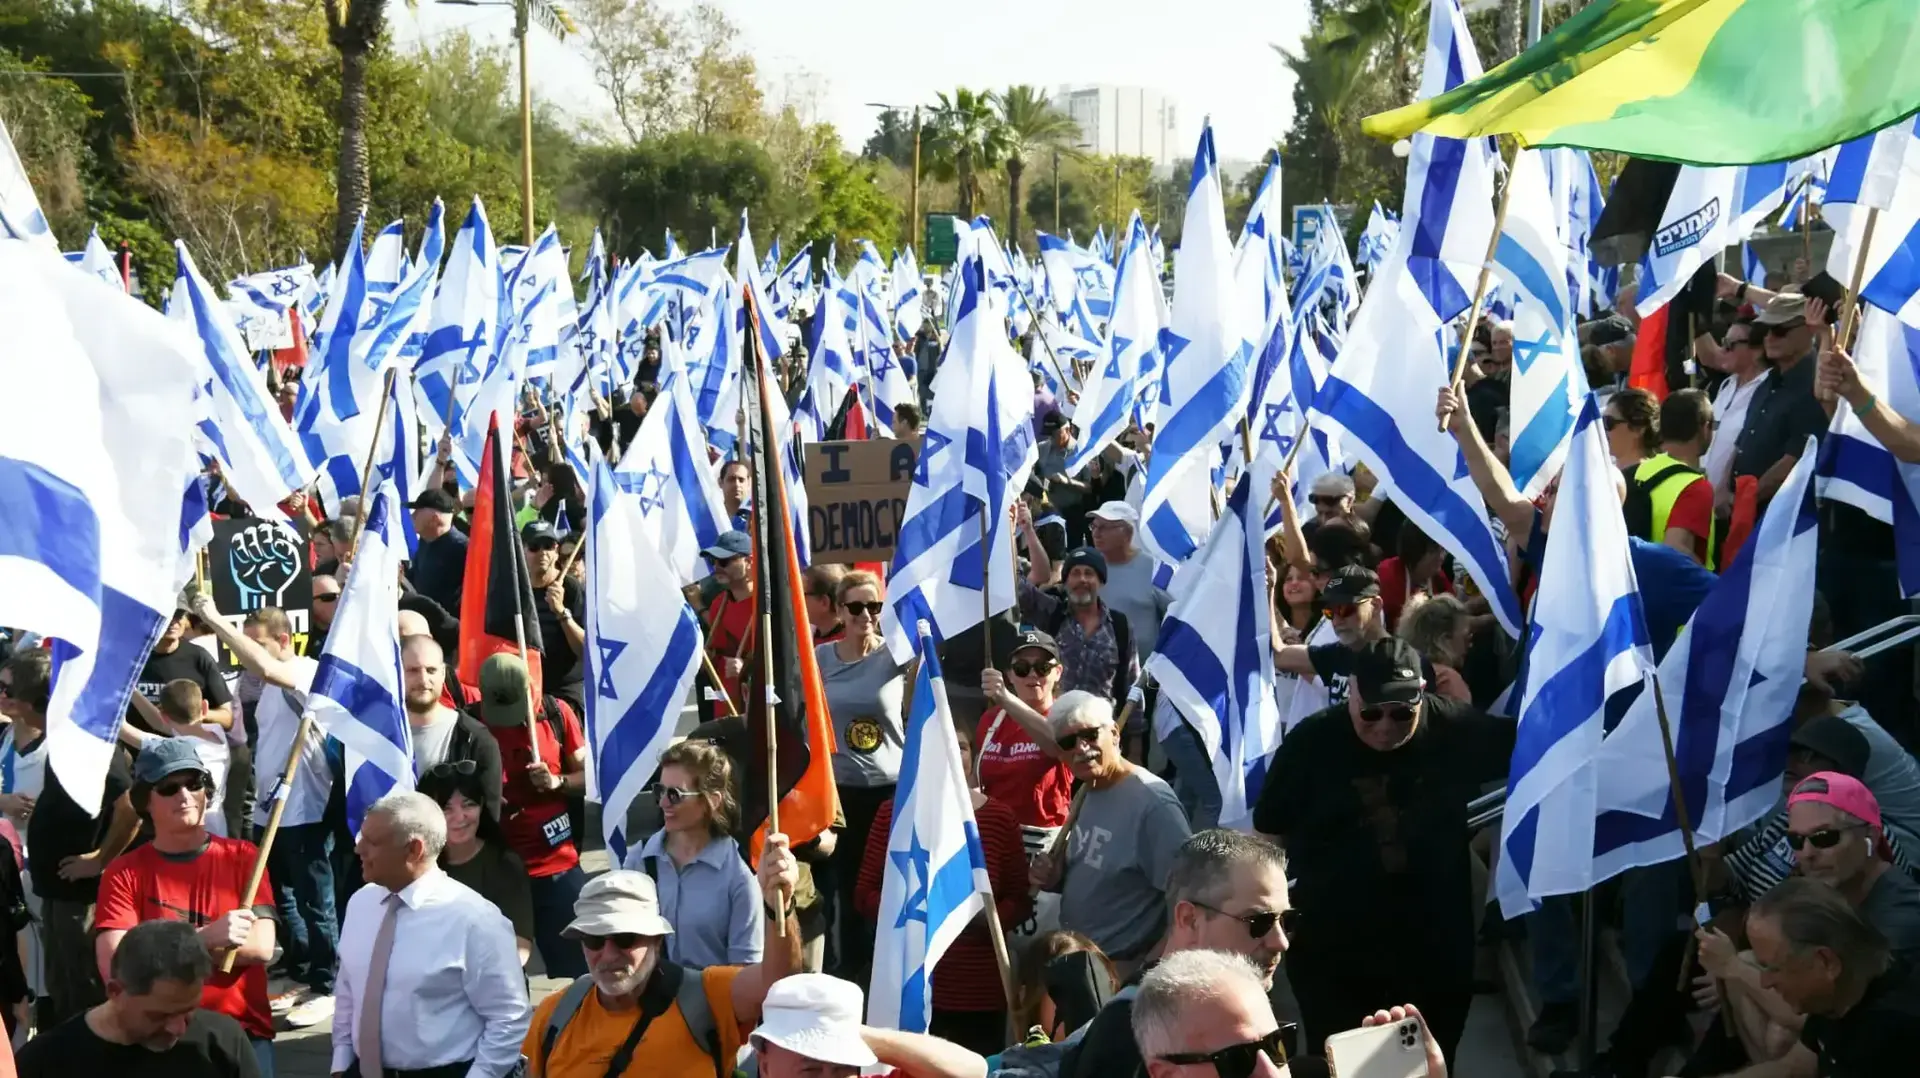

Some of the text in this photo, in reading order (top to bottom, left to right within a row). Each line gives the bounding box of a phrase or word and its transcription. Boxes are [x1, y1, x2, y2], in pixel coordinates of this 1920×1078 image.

[1656, 199, 1718, 248] נאמנים
[821, 443, 916, 483] I A
